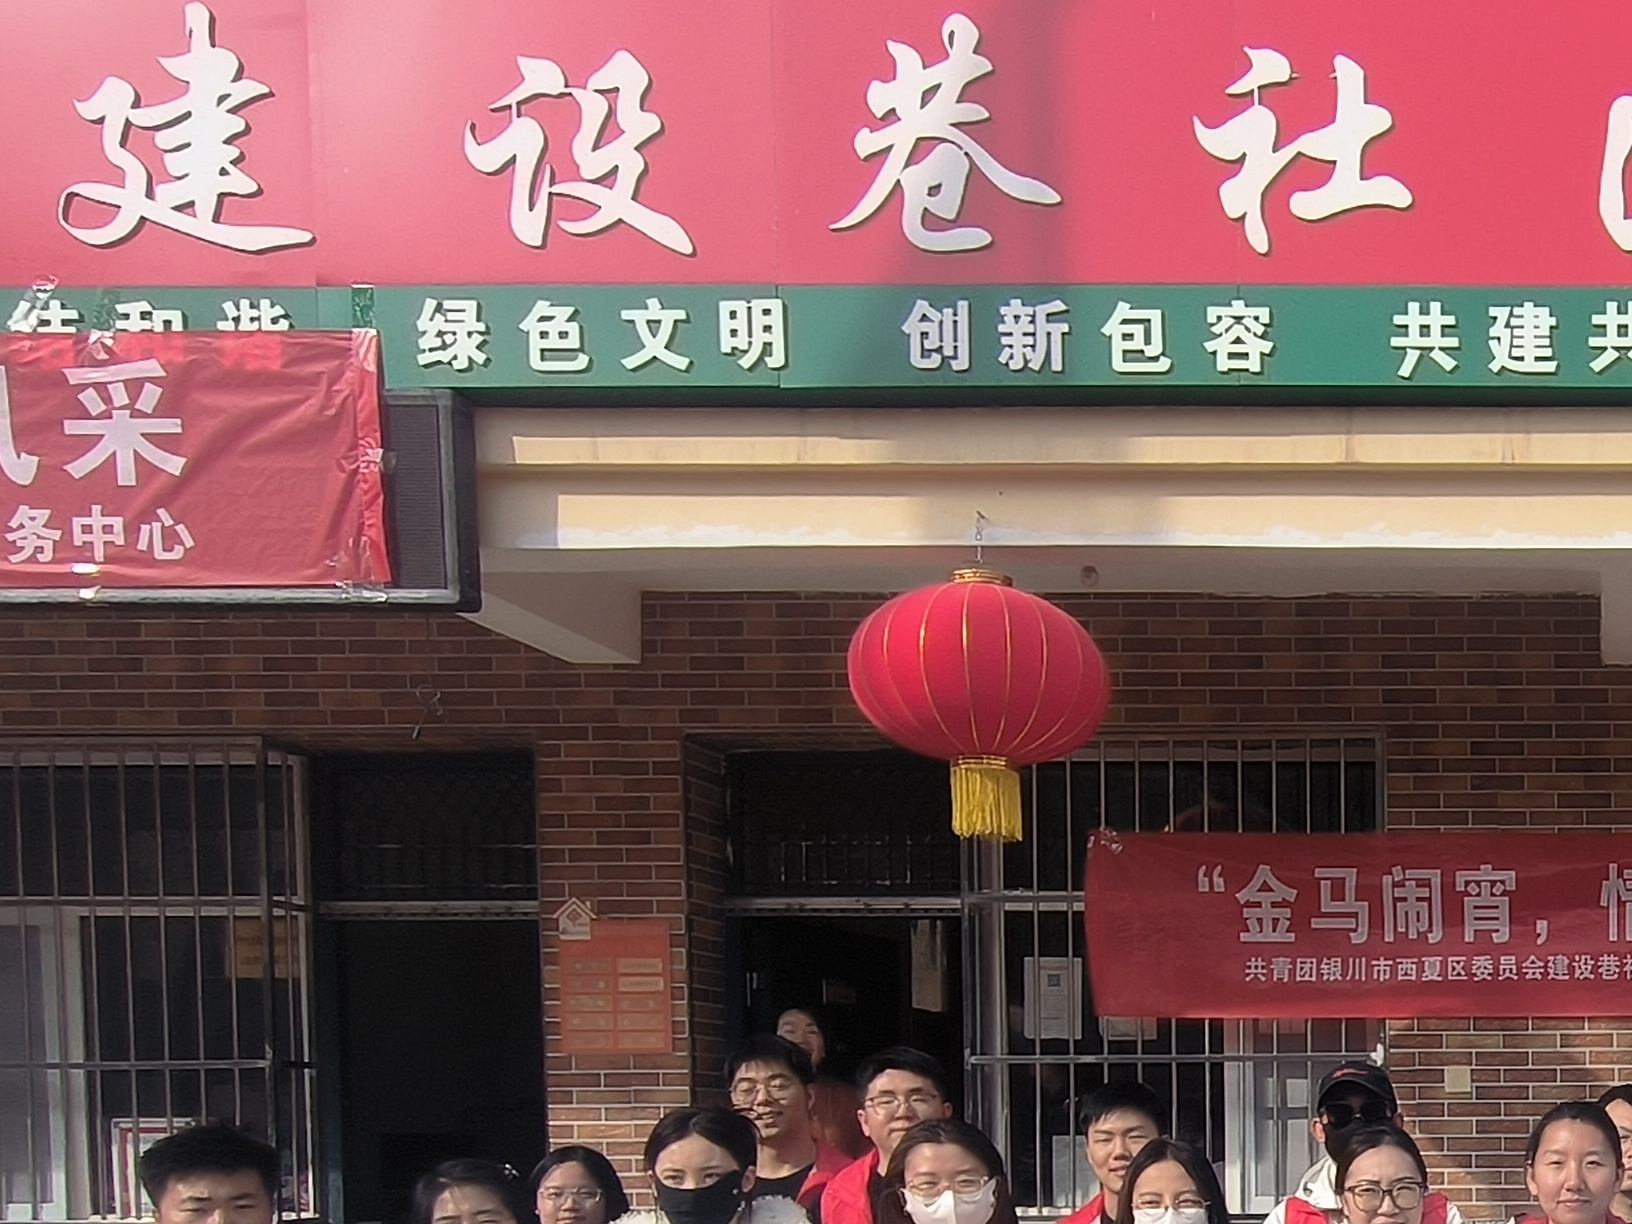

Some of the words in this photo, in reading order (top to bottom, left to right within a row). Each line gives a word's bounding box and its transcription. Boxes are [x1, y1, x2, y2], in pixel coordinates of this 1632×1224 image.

[416, 298, 788, 373] 绿色文明
[902, 300, 1274, 374] 创新包容
[4, 504, 196, 564] 务中心
